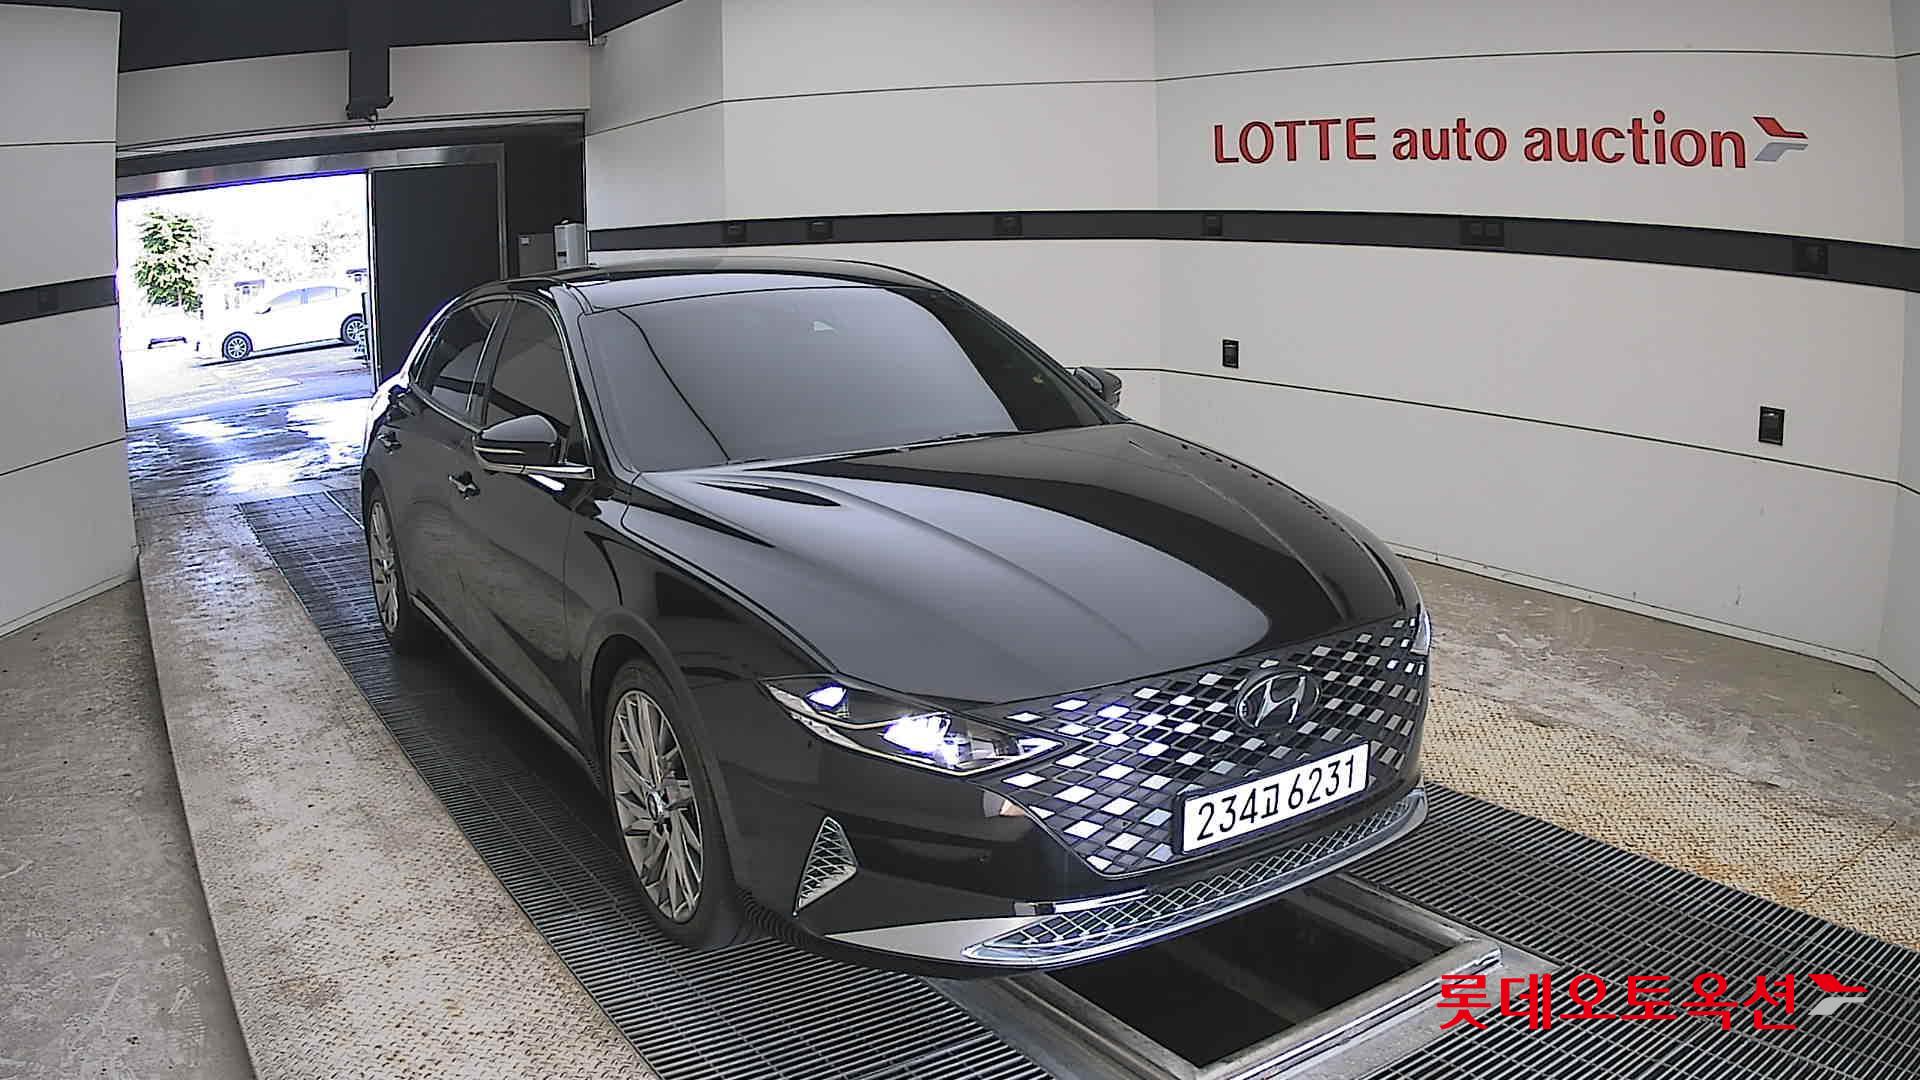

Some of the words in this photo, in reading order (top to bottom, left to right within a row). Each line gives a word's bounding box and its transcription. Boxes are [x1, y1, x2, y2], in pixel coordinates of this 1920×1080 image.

[1213, 116, 1377, 164] LOTTE
[1391, 117, 1507, 162] auto
[1523, 110, 1747, 169] auction
